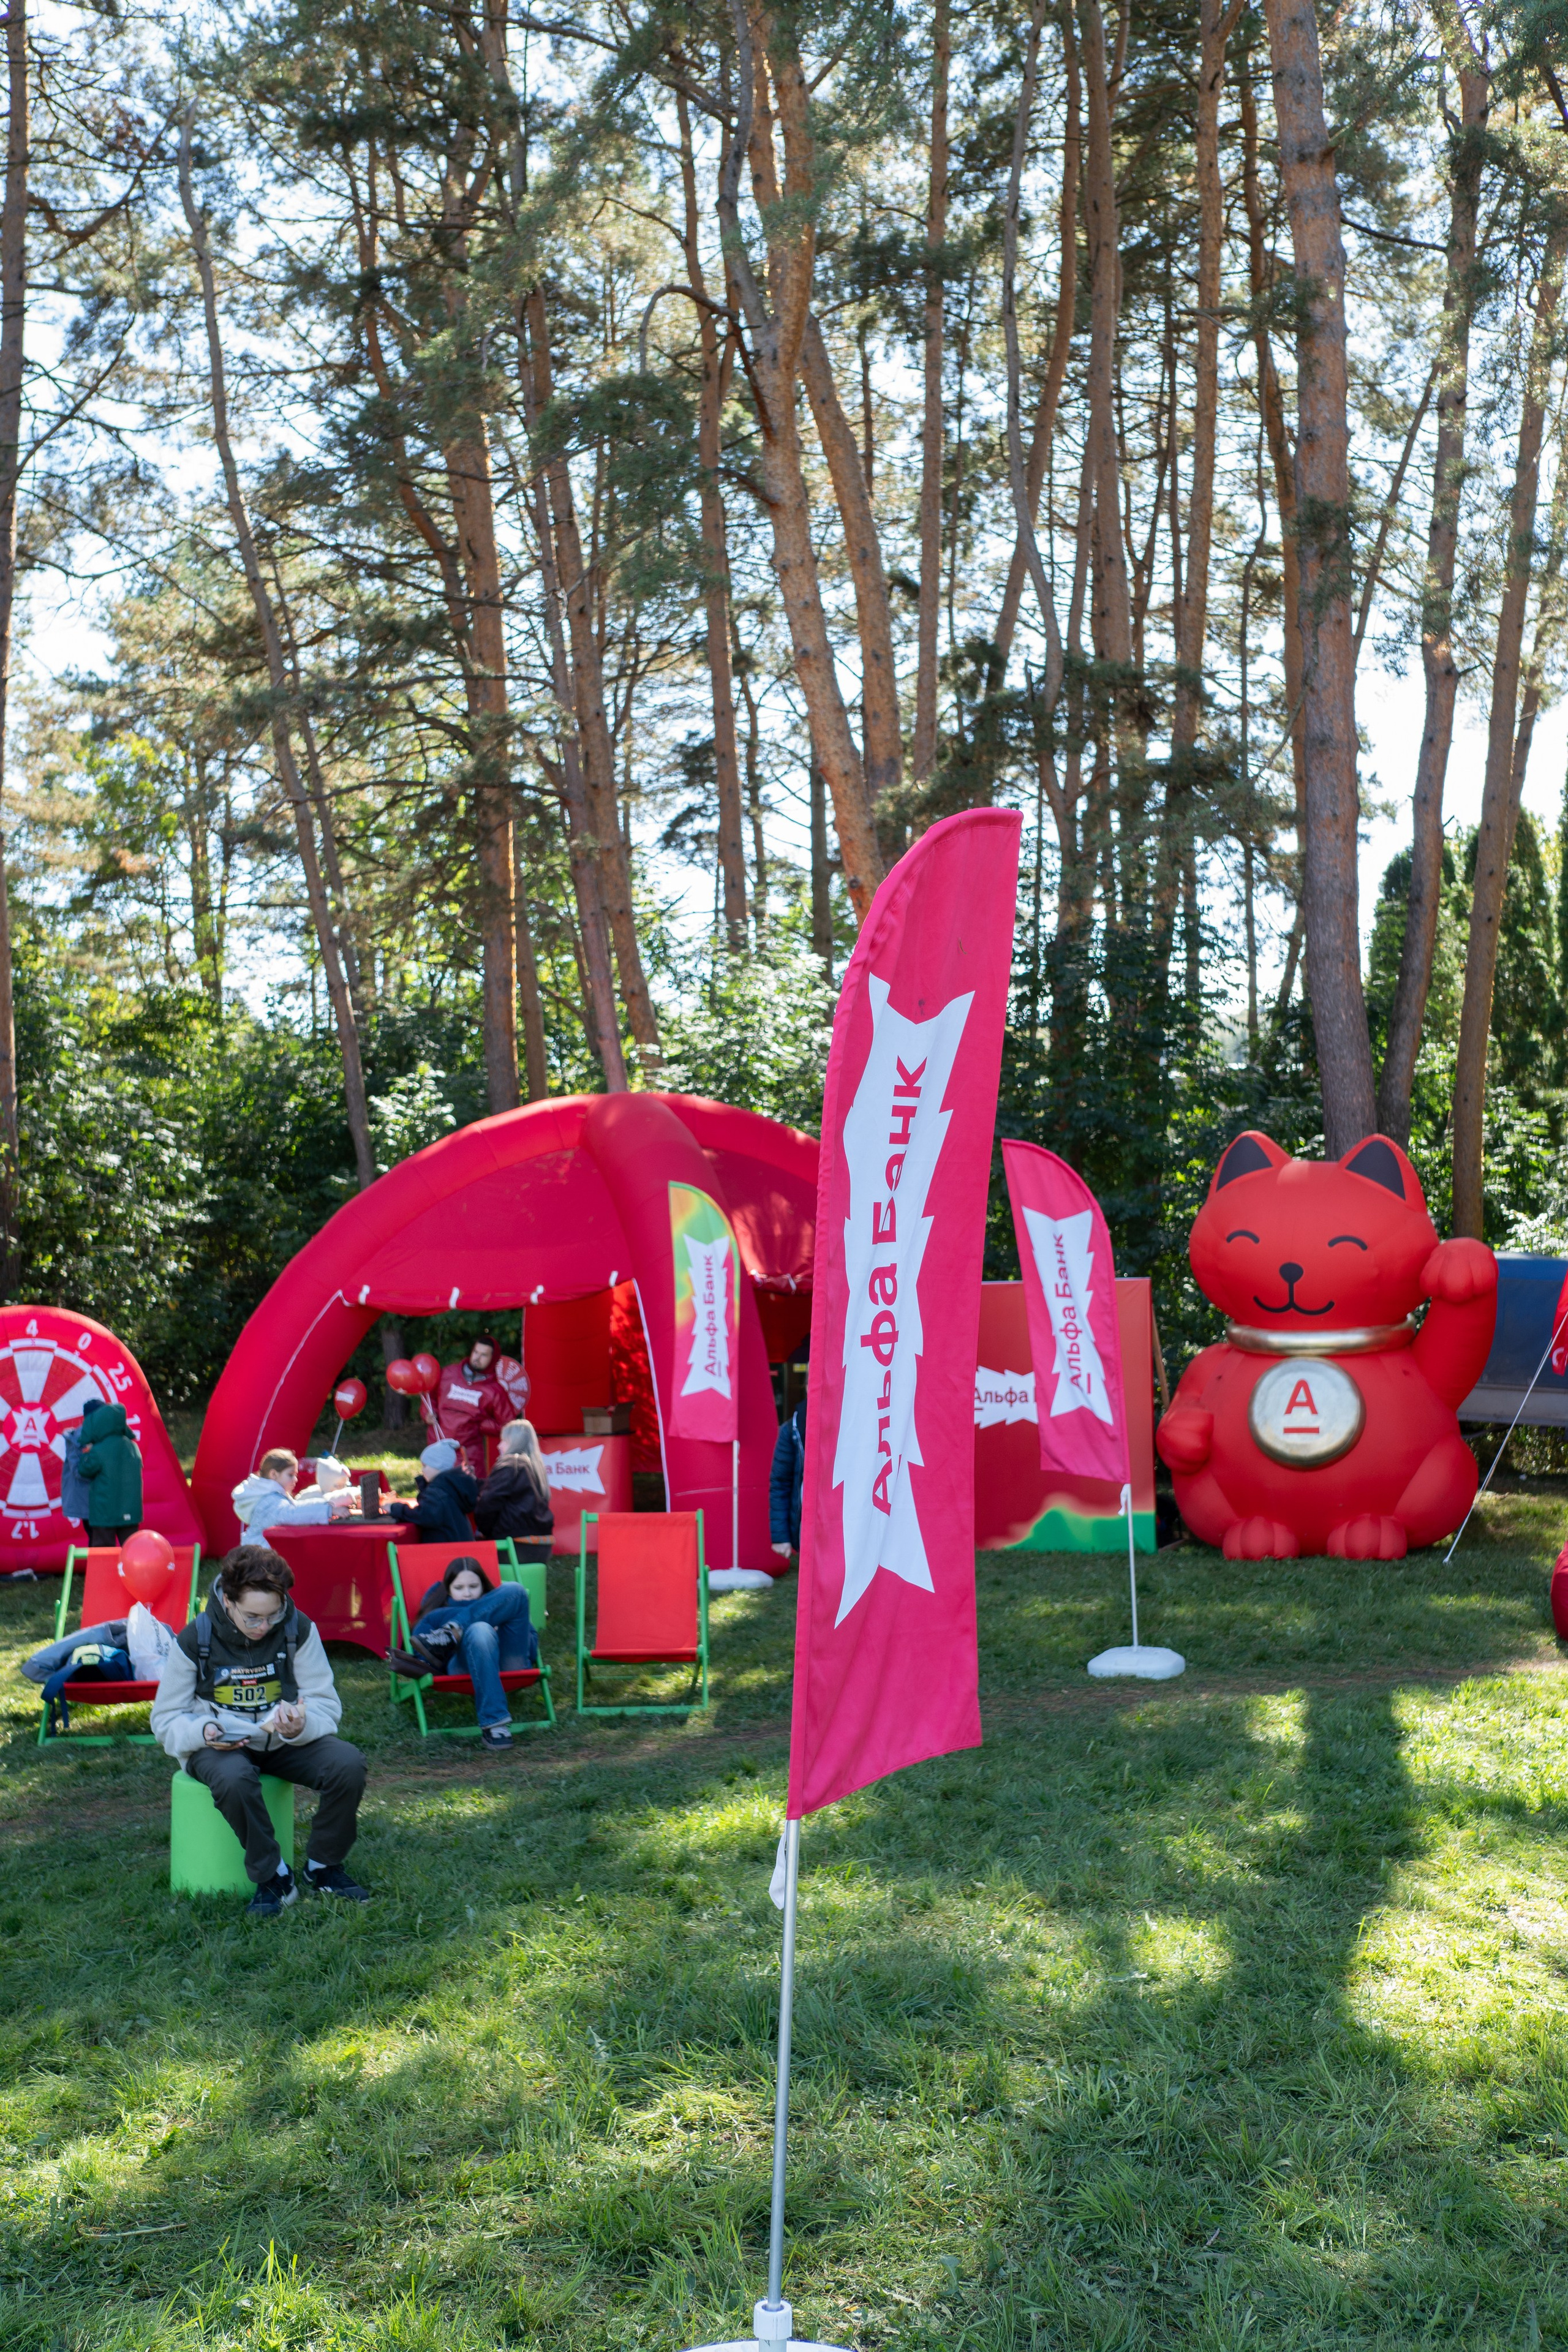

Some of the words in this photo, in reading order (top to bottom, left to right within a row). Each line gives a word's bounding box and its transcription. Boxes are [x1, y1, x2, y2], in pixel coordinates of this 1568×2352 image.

[1054, 1232, 1072, 1300] Банк
[703, 1254, 714, 1305] Банк
[26, 1319, 39, 1336] 4
[78, 1332, 92, 1350] 0
[703, 1310, 719, 1376] Альфа
[1060, 1306, 1083, 1389] Альфа
[555, 1462, 590, 1475] Банк
[11, 1521, 39, 1539] 1.7
[233, 1686, 266, 1702] 502
